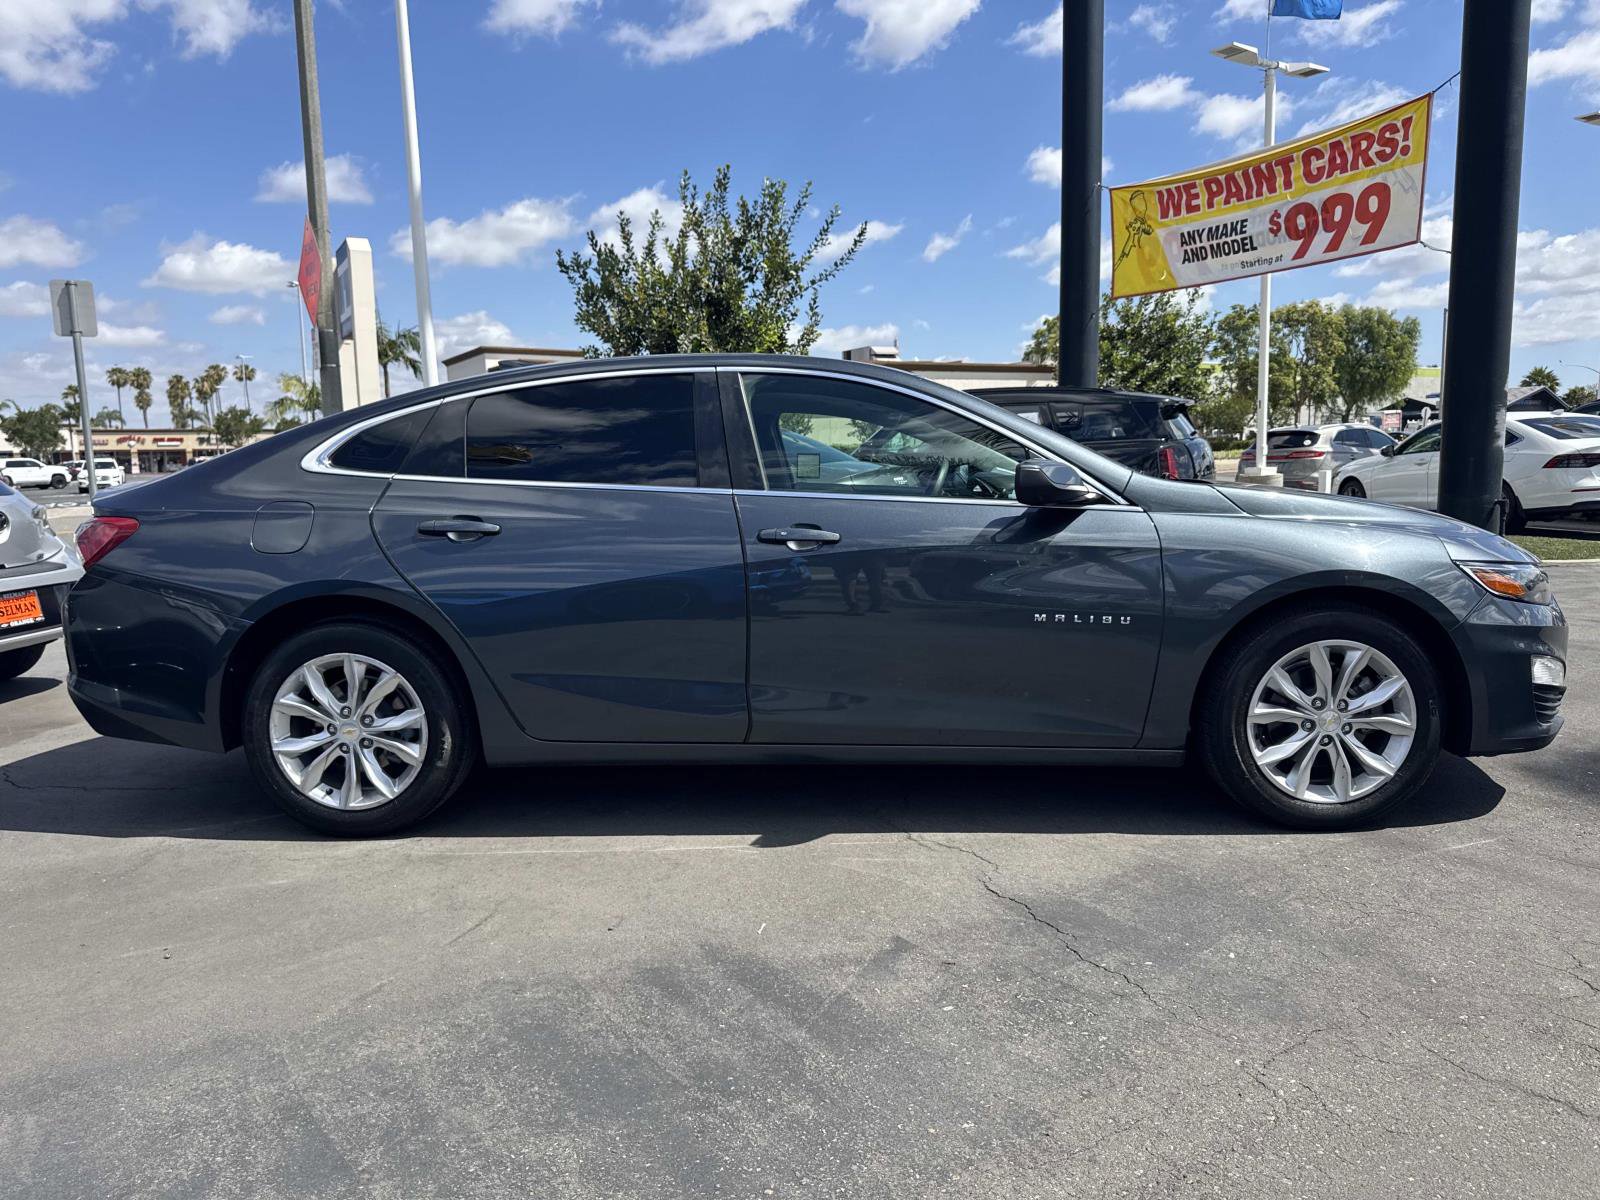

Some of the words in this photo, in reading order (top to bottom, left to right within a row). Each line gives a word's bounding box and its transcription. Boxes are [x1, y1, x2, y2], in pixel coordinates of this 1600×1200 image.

[1156, 181, 1201, 220] WE
[1203, 154, 1295, 210] PAINT
[1301, 115, 1414, 184] CARS!
[1180, 229, 1206, 248] ANY
[1206, 218, 1249, 243] MAKE
[1268, 182, 1392, 260] $999
[1182, 245, 1209, 264] AND
[1210, 235, 1258, 260] MODEL
[1240, 256, 1273, 270] Starting
[1274, 254, 1283, 263] at
[1034, 613, 1131, 624] MALIBU
